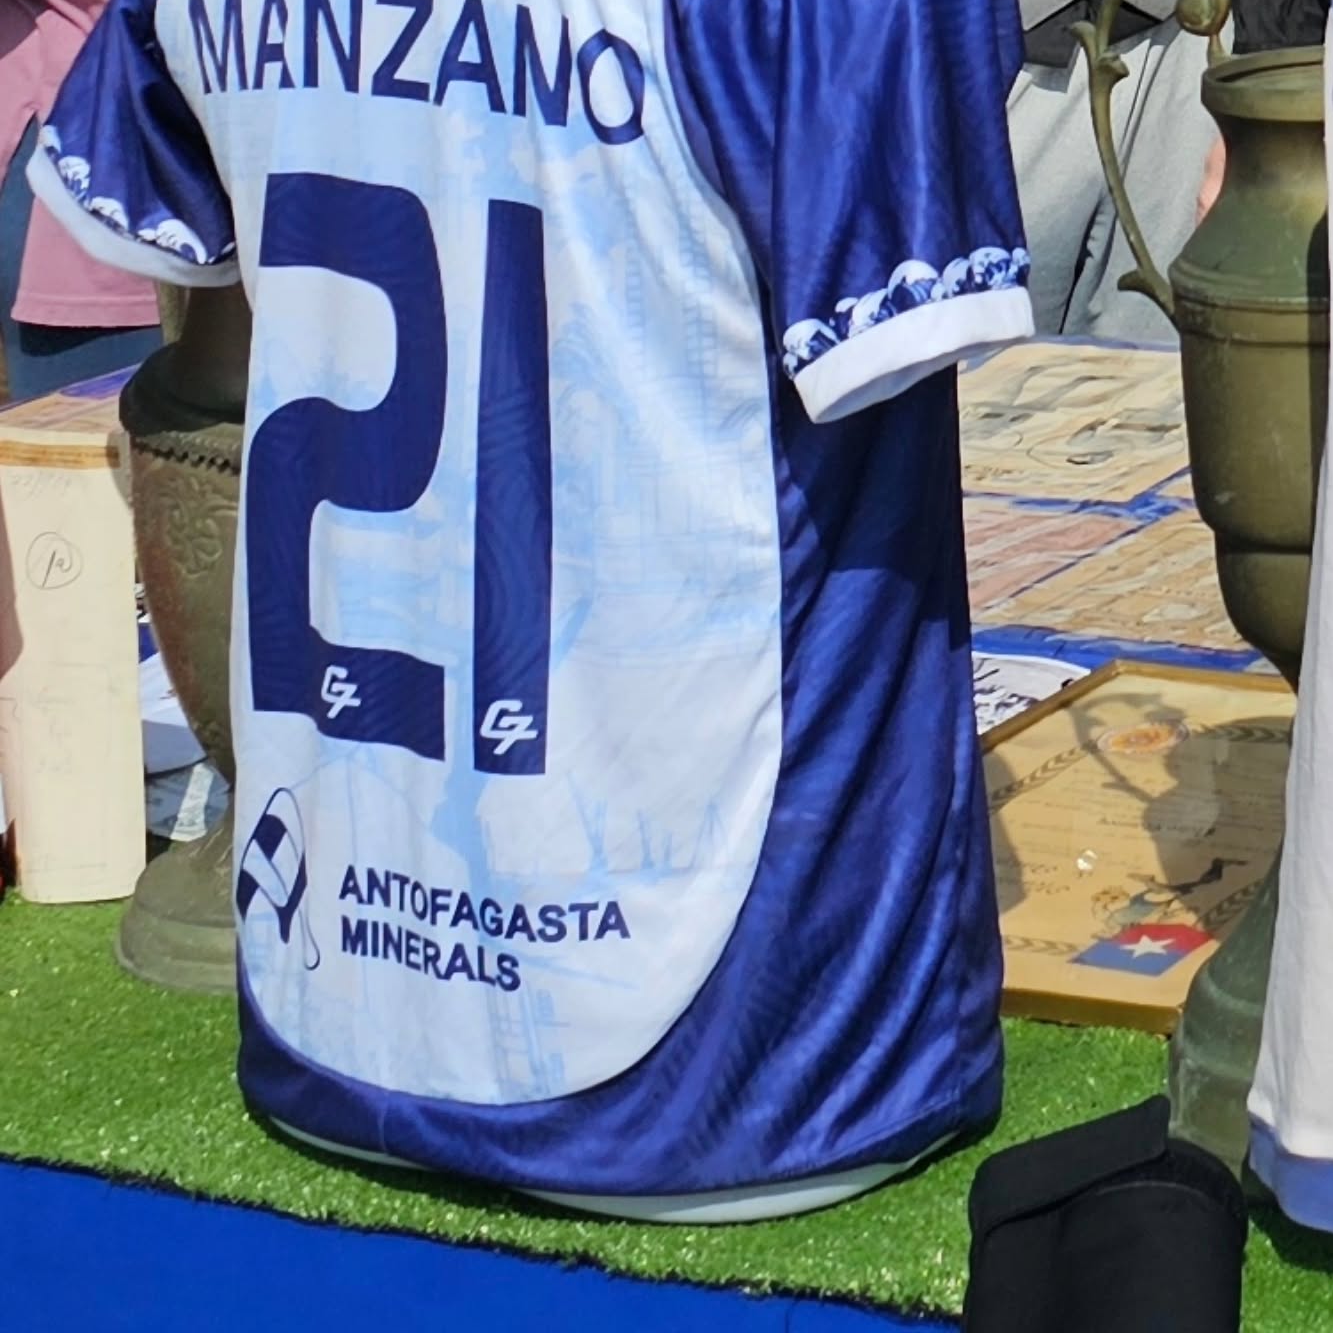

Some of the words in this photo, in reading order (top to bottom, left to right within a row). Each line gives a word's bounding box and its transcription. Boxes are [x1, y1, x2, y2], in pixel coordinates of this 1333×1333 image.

[245, 171, 554, 776] 21
[338, 864, 630, 943] ANTOFAGASTA
[341, 914, 522, 993] MINERALS
